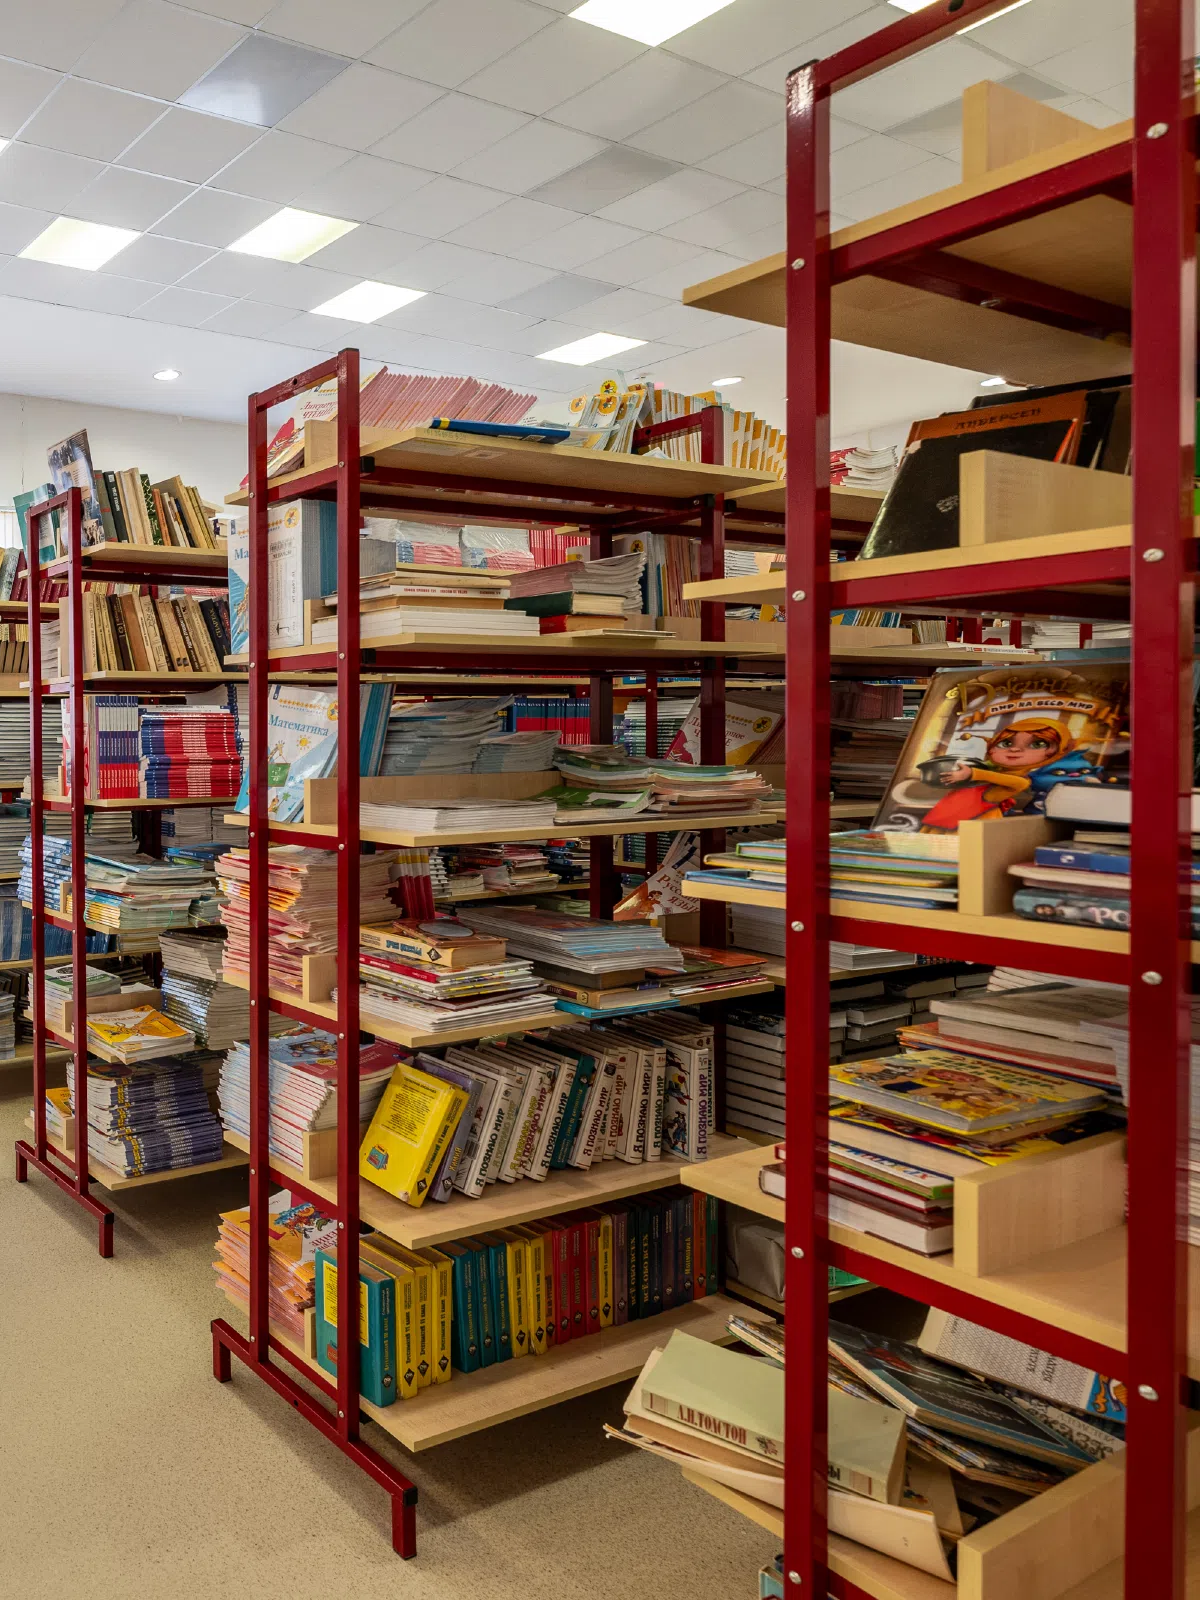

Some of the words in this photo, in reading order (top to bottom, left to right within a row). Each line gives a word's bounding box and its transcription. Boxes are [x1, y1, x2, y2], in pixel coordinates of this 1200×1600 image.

[990, 703, 1014, 713] ПИР
[1018, 700, 1033, 708] НА
[1037, 700, 1064, 708] ВЕСЬ
[1067, 701, 1094, 710] МИР
[268, 713, 329, 737] Математика
[615, 1074, 625, 1096] МИР
[641, 1072, 651, 1095] МИР
[656, 1075, 665, 1096] МИР
[699, 1073, 708, 1096] МИР
[557, 1092, 569, 1114] МИР
[598, 1086, 609, 1109] МИР
[493, 1108, 505, 1131] МИР
[518, 1158, 527, 1169] Я
[523, 1111, 541, 1157] ПОЗНАЮ
[536, 1087, 548, 1112] МИР
[587, 1108, 603, 1149] ПОЗНАЮ
[610, 1098, 621, 1137] ПОЗНАЮ
[636, 1099, 649, 1143] ПОЗНАЮ
[654, 1098, 664, 1137] ПОЗНАЮ
[698, 1100, 707, 1144] ПОЗНАЮ
[544, 1116, 562, 1158] ПОЗНАЮ
[608, 1137, 616, 1147] Я
[633, 1144, 643, 1153] Я
[653, 1138, 661, 1148] Я
[479, 1133, 498, 1177] ПОЗНАЮ
[583, 1148, 592, 1157] Я
[696, 1146, 707, 1155] Я
[541, 1158, 550, 1169] Я
[475, 1177, 484, 1187] Я
